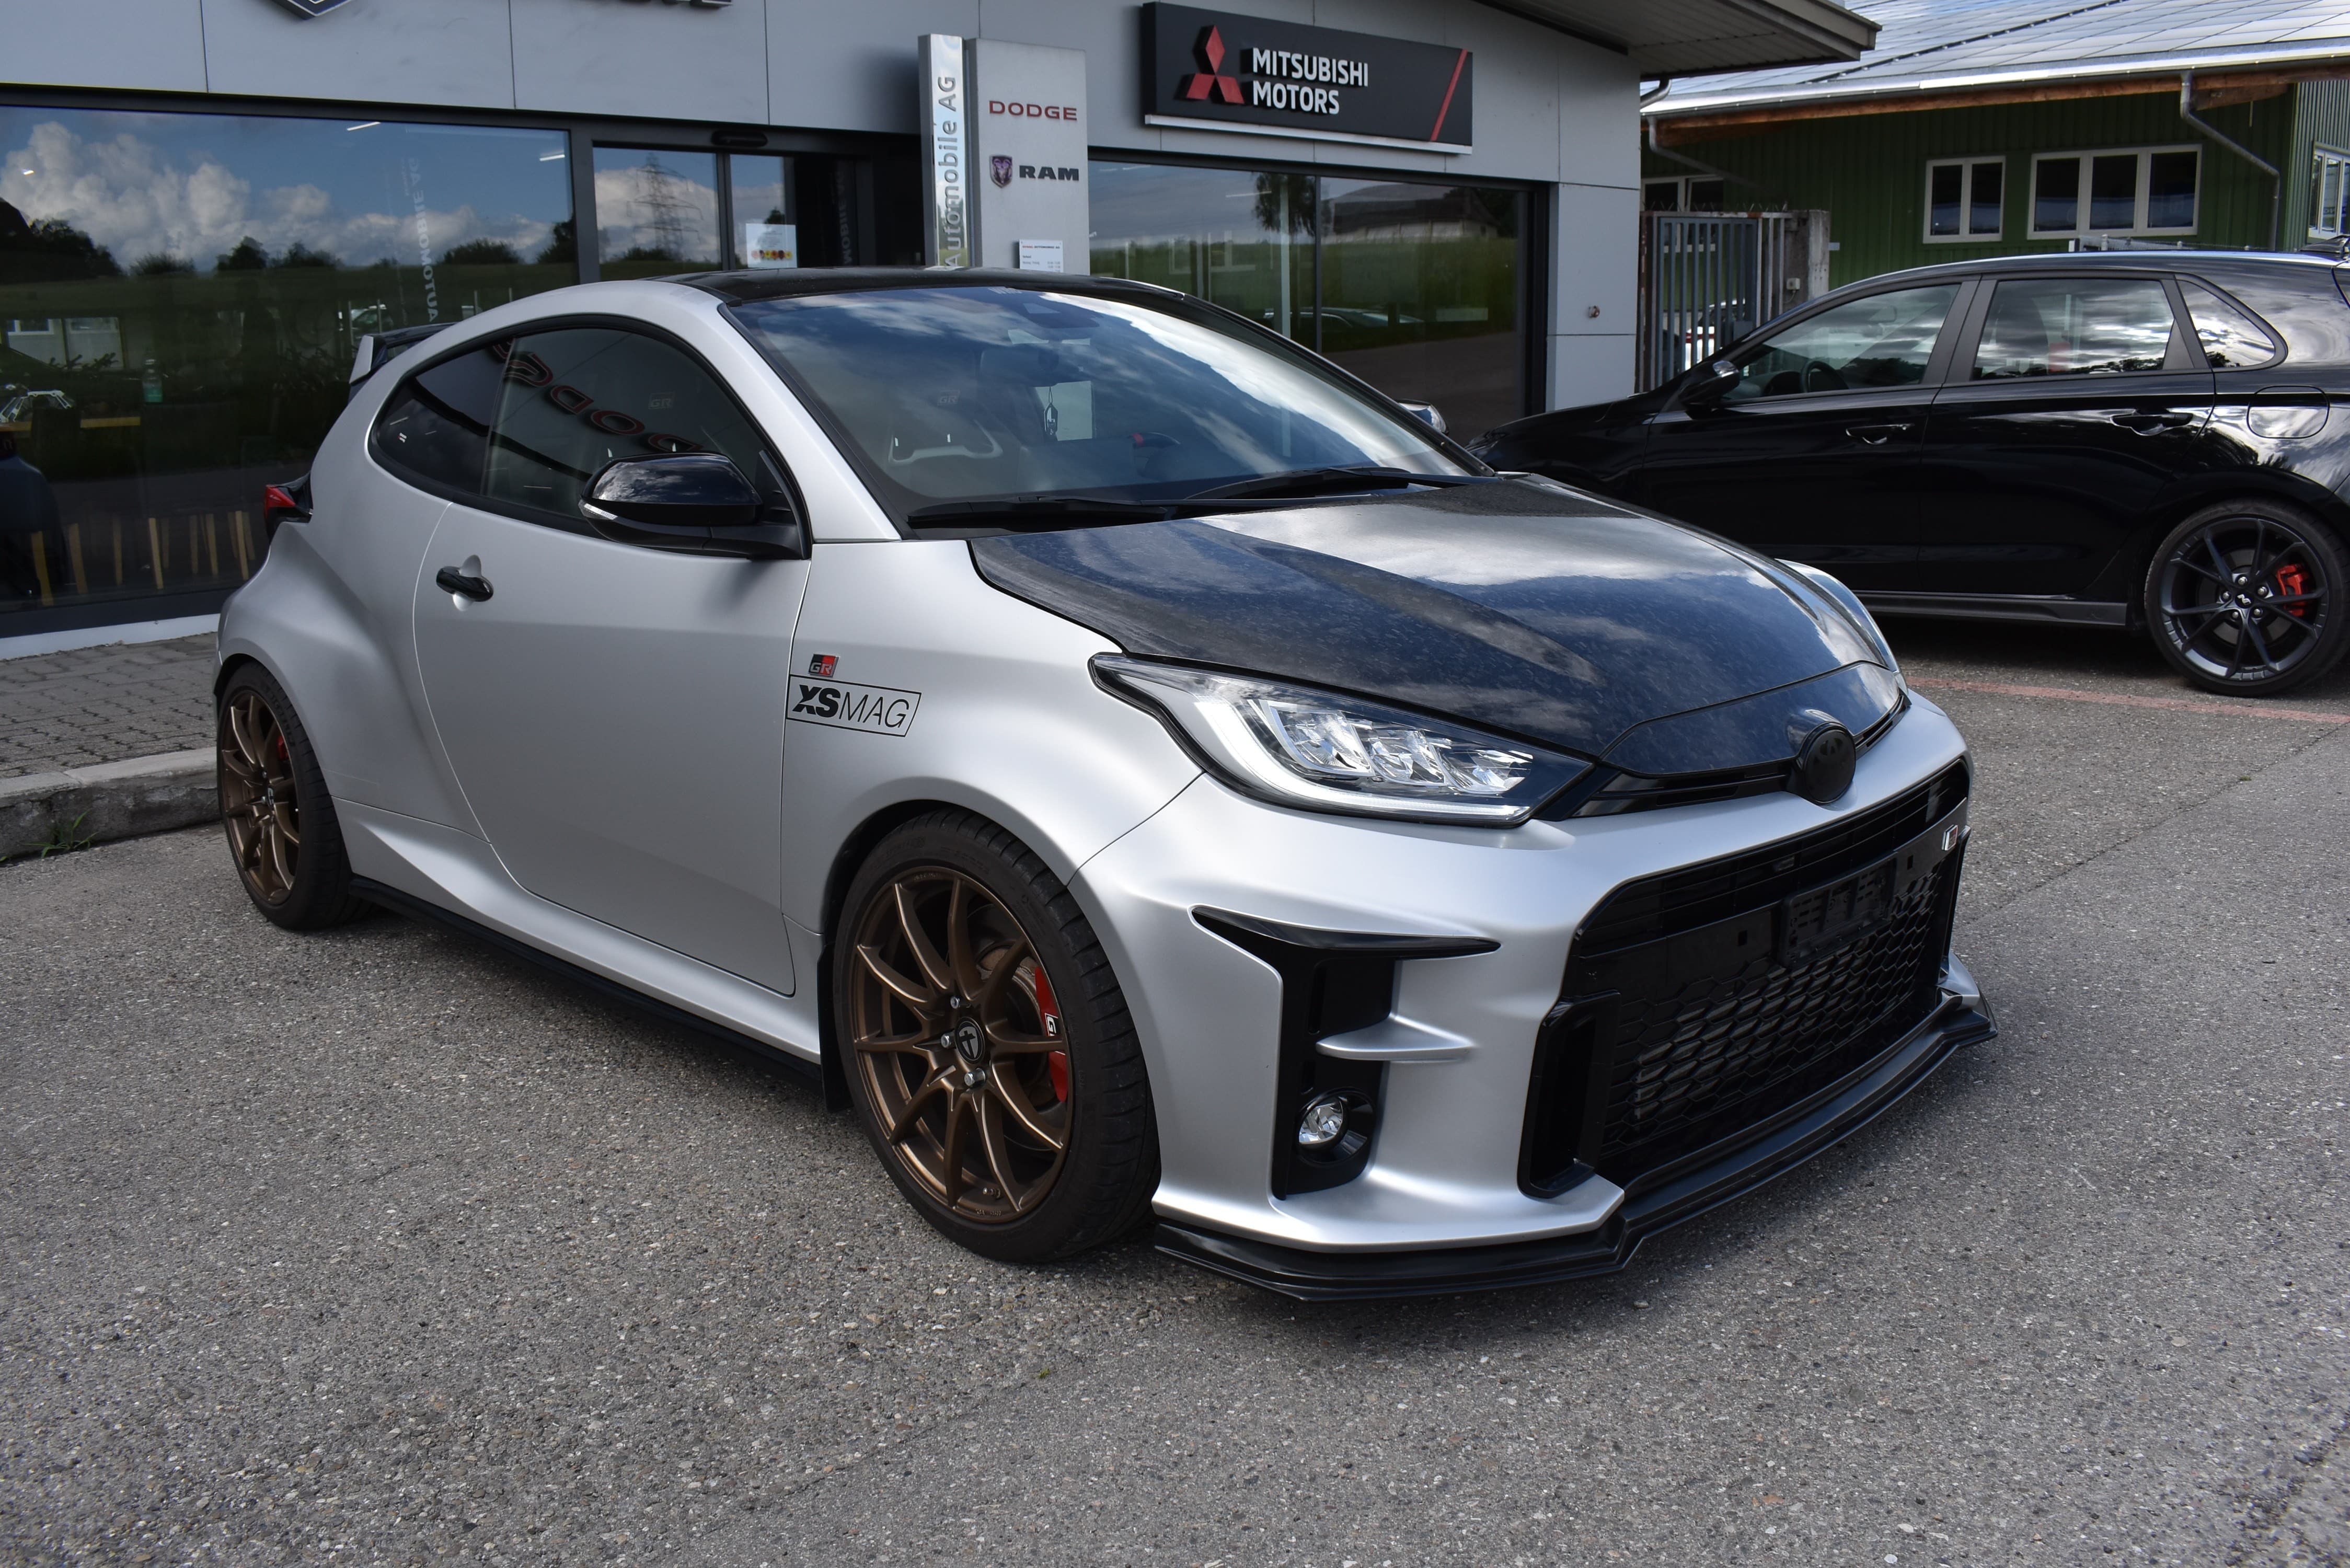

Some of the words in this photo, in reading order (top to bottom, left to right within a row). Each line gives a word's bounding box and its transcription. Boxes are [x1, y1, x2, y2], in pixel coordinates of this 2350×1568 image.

[1253, 47, 1368, 86] MITSUBISHI
[938, 77, 956, 111] AG
[989, 100, 1077, 121] DODGE
[1253, 80, 1340, 114] MOTORS
[1019, 165, 1079, 181] RAM
[938, 121, 962, 267] Automobile
[810, 662, 832, 674] GR
[792, 684, 909, 728] XSMAG
